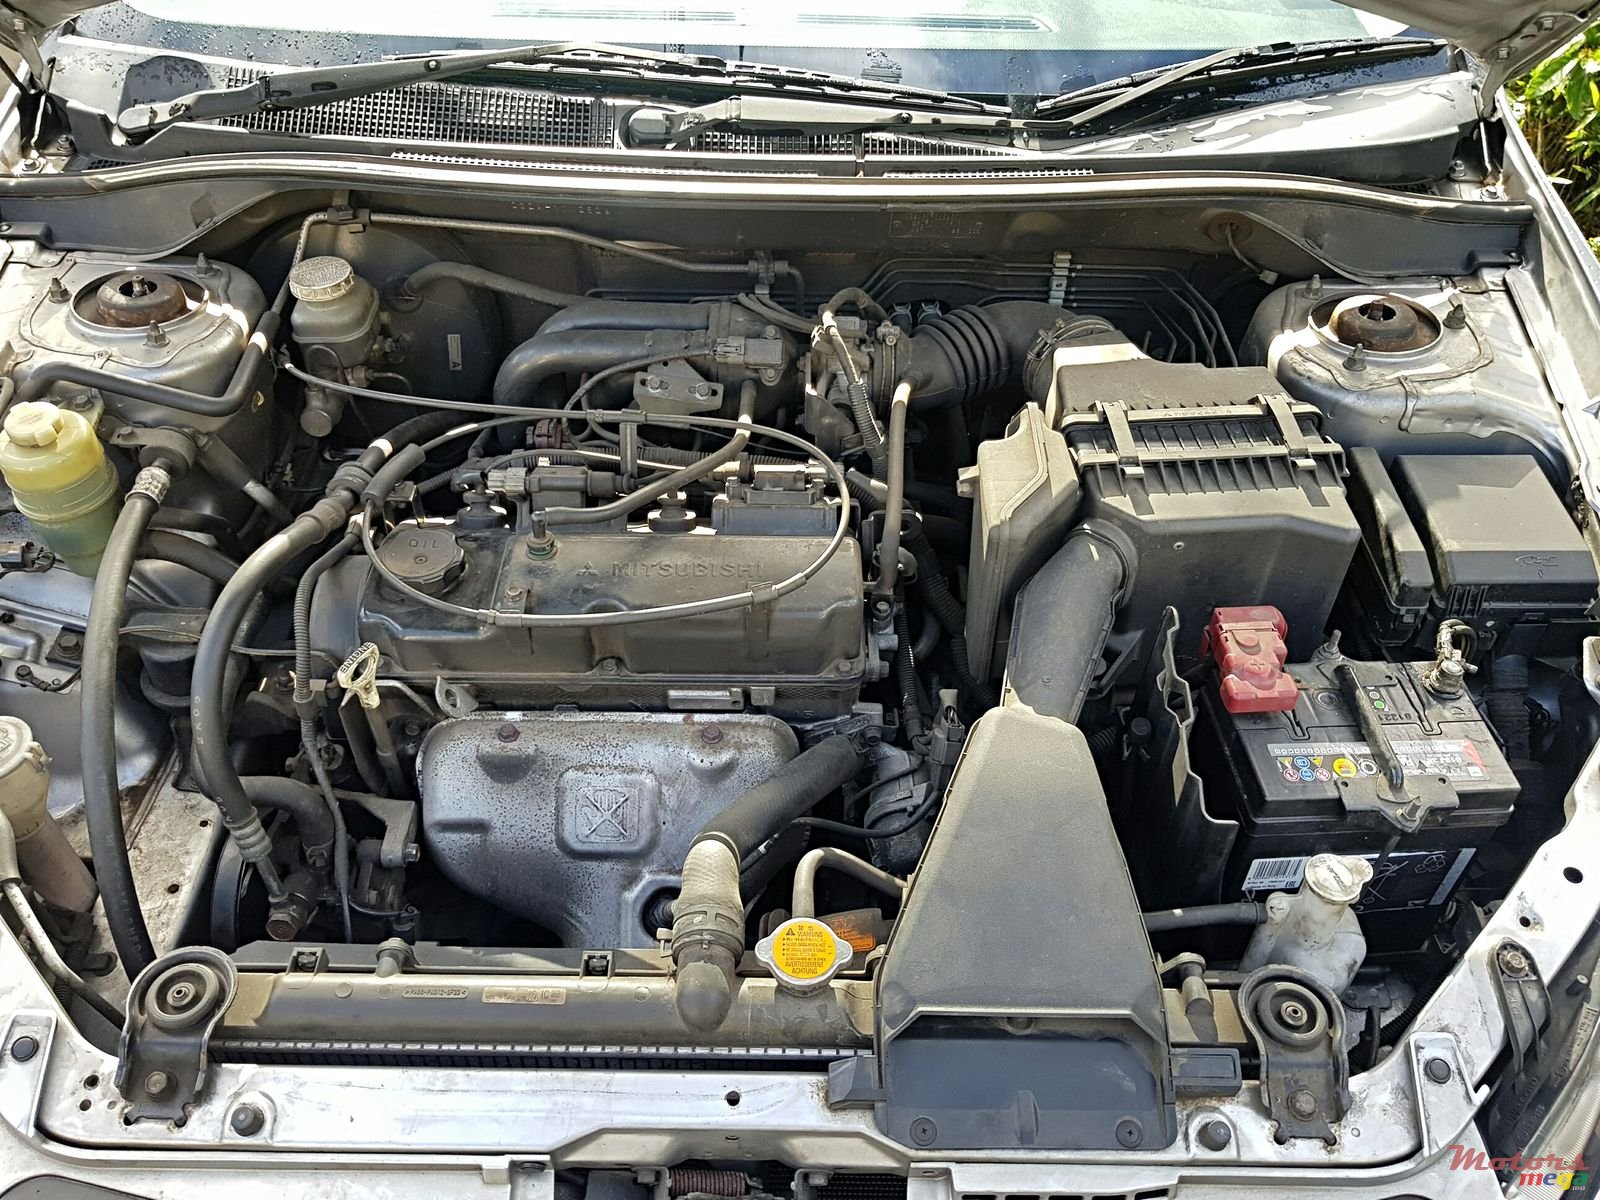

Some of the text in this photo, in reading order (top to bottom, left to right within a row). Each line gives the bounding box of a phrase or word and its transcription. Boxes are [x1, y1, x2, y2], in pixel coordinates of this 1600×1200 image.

[408, 537, 440, 550] OIL
[611, 560, 764, 578] MITSUBISHI
[339, 640, 375, 675] ENGINE
